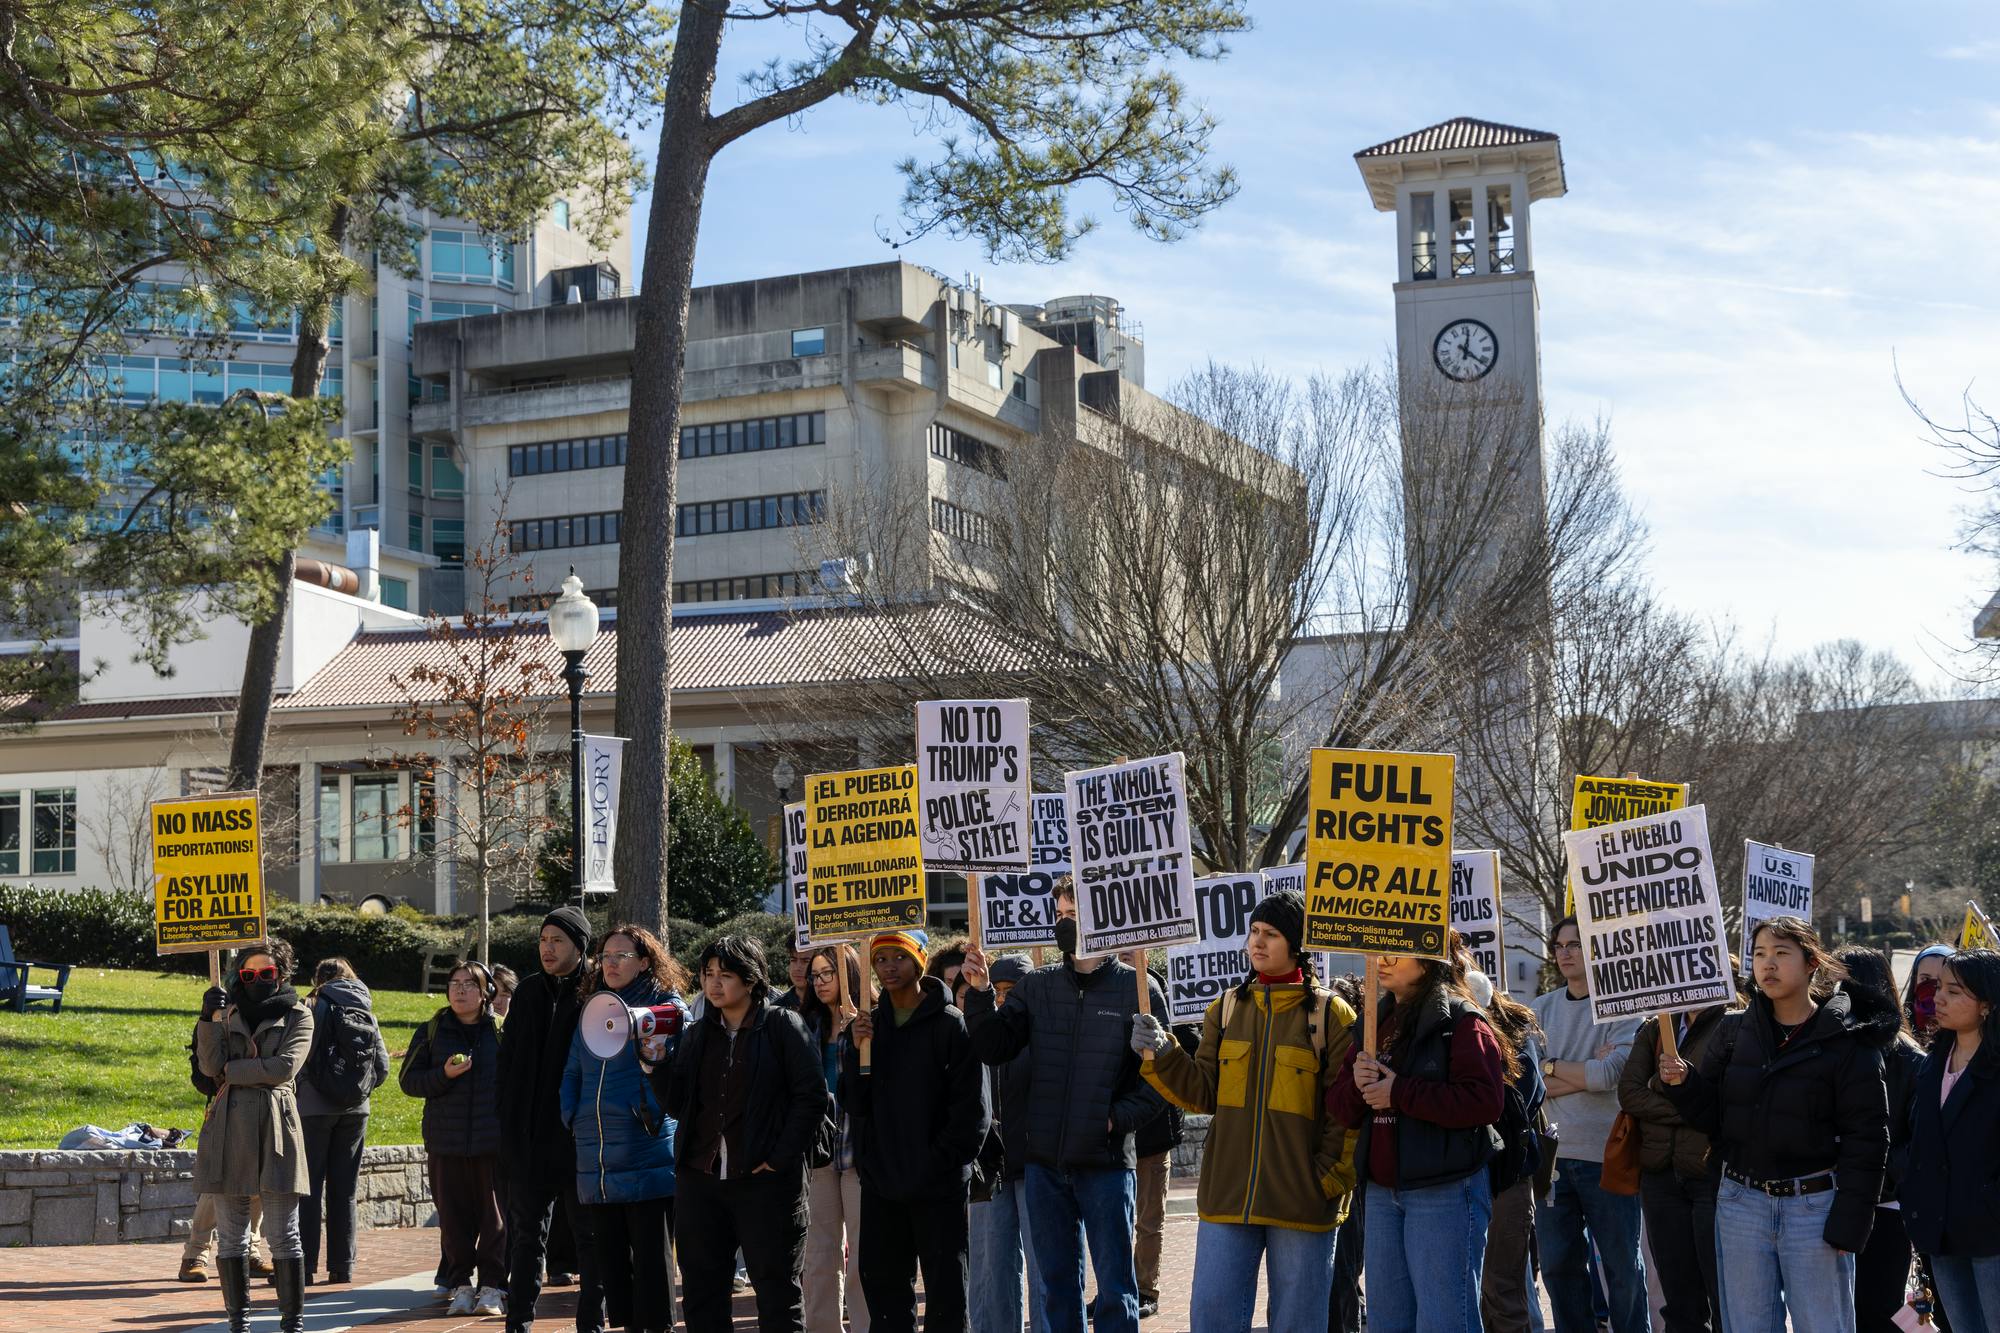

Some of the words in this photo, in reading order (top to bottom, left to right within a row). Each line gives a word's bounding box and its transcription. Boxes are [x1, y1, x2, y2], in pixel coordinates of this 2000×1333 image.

[940, 707, 969, 743] NO
[973, 707, 1001, 743] TO
[927, 746, 1017, 782] TRUMP'S
[593, 749, 610, 846] EMORY
[814, 780, 840, 804] ¡EL
[845, 770, 913, 796] PUEBLO
[1076, 775, 1107, 808] THE
[1109, 763, 1172, 802] WHOLE
[1331, 762, 1432, 805] FULL
[1579, 781, 1679, 800] ARREST
[158, 813, 185, 835] NO
[192, 809, 252, 833] MASS
[817, 793, 912, 823] DERROTARÁ
[926, 789, 994, 832] POLICE
[1038, 799, 1064, 819] FOR
[1077, 794, 1176, 825] SYSTEM
[1585, 795, 1670, 821] JONATHAN
[789, 810, 806, 846] IC
[813, 828, 836, 848] LA
[841, 819, 917, 845] AGENDA
[958, 822, 1019, 864] STATE!
[1032, 819, 1068, 845] LE'S
[1081, 824, 1100, 862] IS
[1104, 811, 1174, 858] GUILTY
[1316, 809, 1443, 846] RIGHTS
[1596, 832, 1620, 863] ¡EL
[1621, 820, 1682, 853] PUEBLO
[158, 840, 253, 858] DEPORTATIONS!
[813, 856, 917, 880] MULTIMILLONARIA
[1081, 857, 1153, 884] SHUT
[1158, 852, 1182, 871] IT
[1314, 861, 1380, 893] FOR
[1384, 867, 1441, 897] ALL
[1581, 847, 1702, 885] UNIDO
[1765, 858, 1795, 878] U.S.
[167, 873, 248, 897] ASYLUM
[814, 884, 838, 905] DE
[843, 874, 917, 901] TRUMP!
[1588, 867, 1706, 922] DEFENDERÁ
[1749, 874, 1787, 906] HANDS
[1789, 884, 1810, 911] OFF
[164, 898, 202, 920] FOR
[209, 895, 252, 918] ALL!
[844, 910, 877, 919] Socialism
[987, 900, 1015, 928] ICE
[1018, 900, 1042, 926] &
[1090, 873, 1181, 930] DOWN!
[1195, 881, 1256, 940] TOP
[1311, 895, 1441, 922] IMMIGRANTS
[1451, 898, 1492, 922] POLIS
[815, 921, 848, 930] Liberation
[857, 915, 899, 925] PSLWeb.org
[988, 931, 1006, 941] PARTY
[1006, 930, 1017, 940] FOR
[1018, 929, 1047, 939] SOCIALISM
[1048, 930, 1055, 938] &
[1087, 937, 1105, 949] PARTY
[1105, 936, 1116, 946] FOR
[1117, 930, 1148, 944] SOCIALISM
[1149, 929, 1158, 939] &
[1158, 923, 1193, 937] LIBERATION
[1312, 921, 1332, 931] Party
[1335, 923, 1345, 931] for
[1347, 924, 1386, 935] Socialism
[1388, 928, 1403, 936] and
[1591, 935, 1602, 960] A
[1604, 928, 1635, 957] LAS
[1635, 915, 1716, 953] FAMILIAS
[1312, 931, 1351, 942] Liberation
[1363, 935, 1414, 948] PSLWeb.org
[1171, 955, 1195, 981] ICE
[1198, 949, 1249, 977] TERRO
[1592, 946, 1723, 996] MIGRANTES!
[1174, 1004, 1190, 1013] PARTY
[1191, 1003, 1199, 1011] FOR
[1597, 1003, 1620, 1015] PARTY
[1620, 999, 1635, 1011] FOR
[1635, 994, 1672, 1009] SOCIALISM
[1672, 992, 1683, 1003] &
[1683, 986, 1726, 1000] LIBERATION
